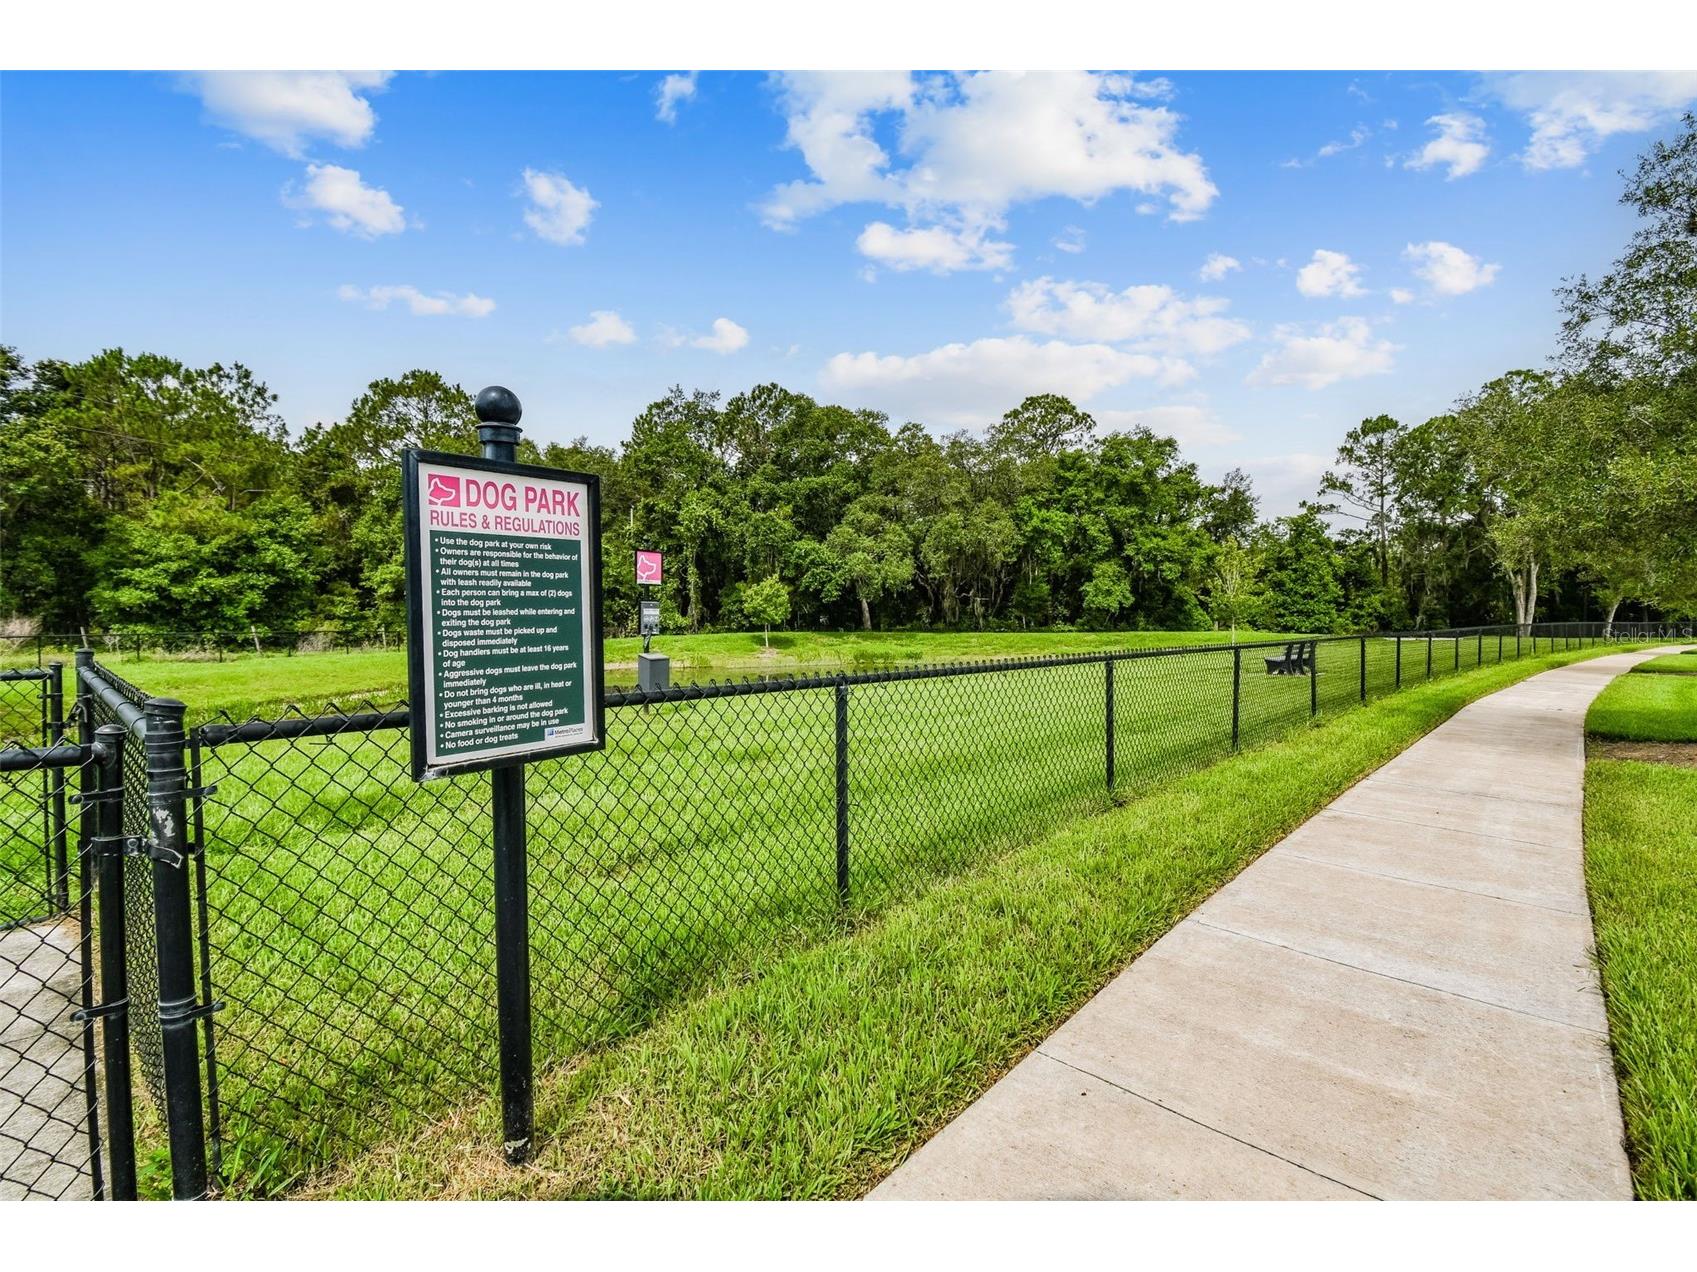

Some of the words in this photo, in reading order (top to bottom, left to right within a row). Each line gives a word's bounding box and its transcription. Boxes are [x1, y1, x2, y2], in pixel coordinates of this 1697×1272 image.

[466, 479, 517, 511] DOG
[525, 486, 580, 517] PARK
[430, 510, 477, 528] RULES
[482, 515, 490, 529] &
[495, 516, 580, 536] REGULATIONS
[469, 539, 483, 547] dog
[440, 547, 468, 556] Owners
[459, 558, 481, 567] dog(s)
[479, 579, 501, 587] readily
[442, 609, 461, 618] Dogs
[442, 619, 466, 627] exiting
[443, 630, 462, 638] Dogs
[514, 627, 535, 635] picked
[442, 639, 475, 648] disposed
[443, 650, 458, 658] Dog
[444, 668, 484, 679] Aggressive
[486, 667, 502, 675] dogs
[444, 678, 486, 688] immediately
[444, 700, 474, 710] younger
[445, 709, 481, 718] Excessive
[483, 706, 508, 714] barking
[529, 700, 552, 708] allowed
[457, 718, 487, 727] smoking
[506, 712, 529, 721] around
[555, 707, 568, 716] park
[475, 724, 515, 734] surveillance
[458, 738, 474, 747] food
